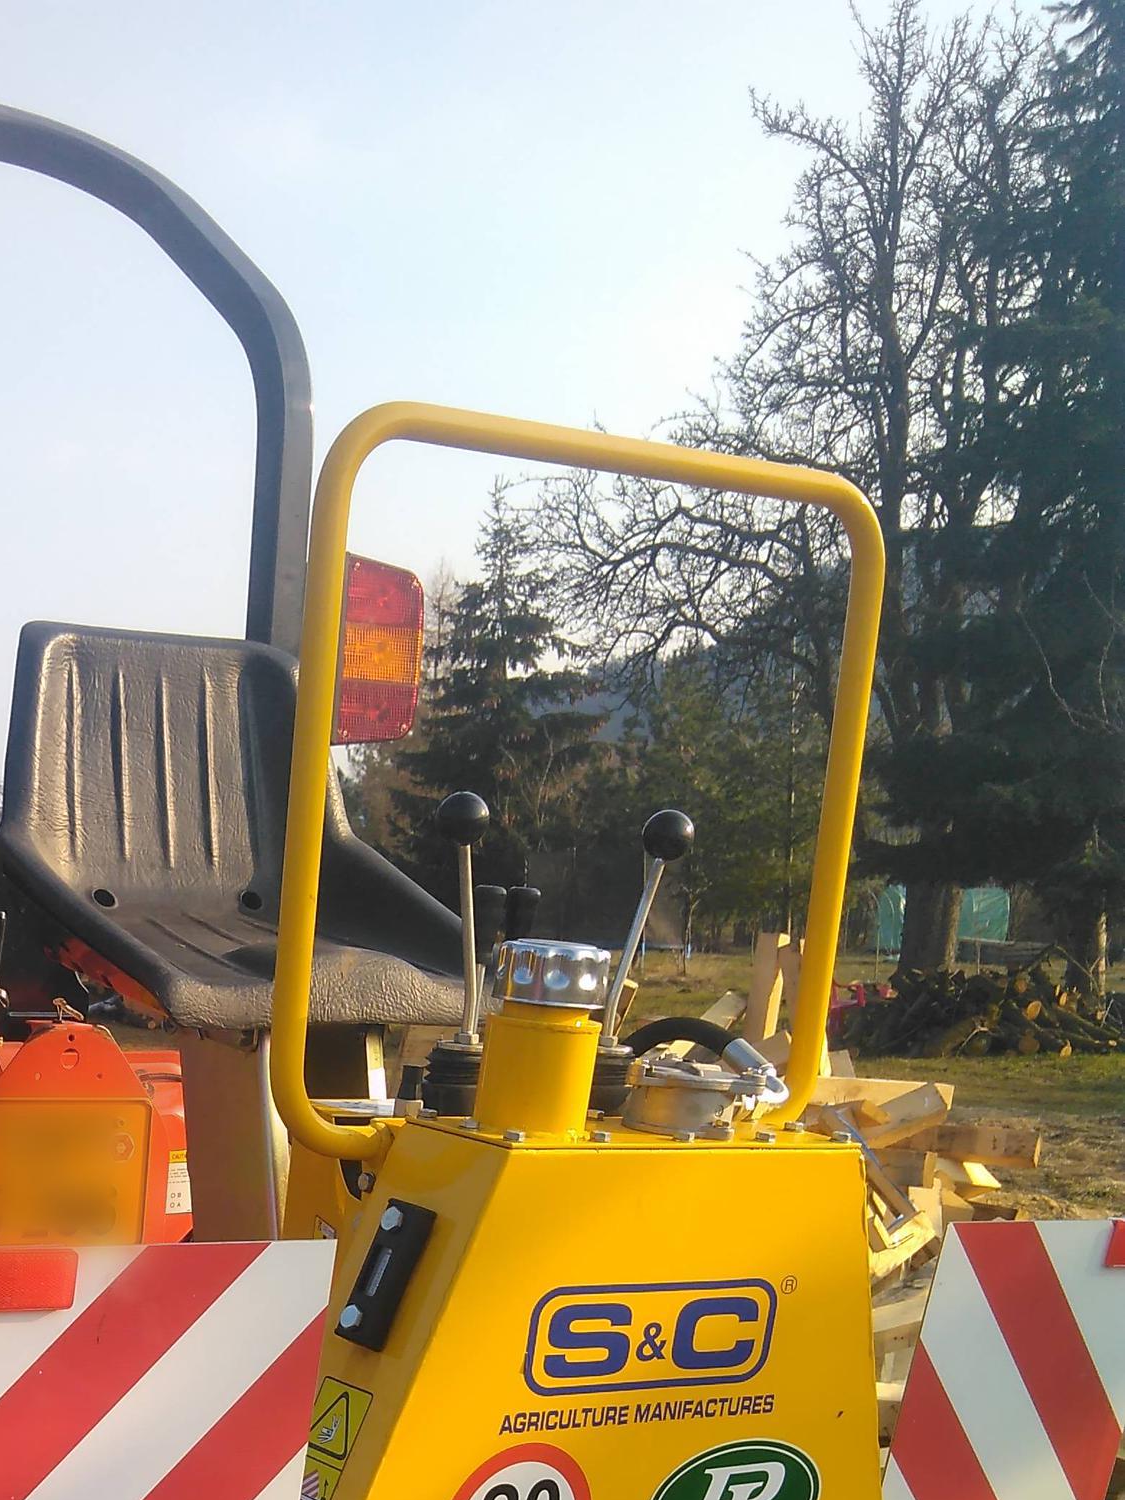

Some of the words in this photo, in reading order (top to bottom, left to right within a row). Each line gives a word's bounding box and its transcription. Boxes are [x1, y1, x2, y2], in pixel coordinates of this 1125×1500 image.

[543, 1296, 759, 1378] S&C
[499, 1405, 630, 1435] AGRICULTURE
[633, 1394, 775, 1423] MANIFACTURES
